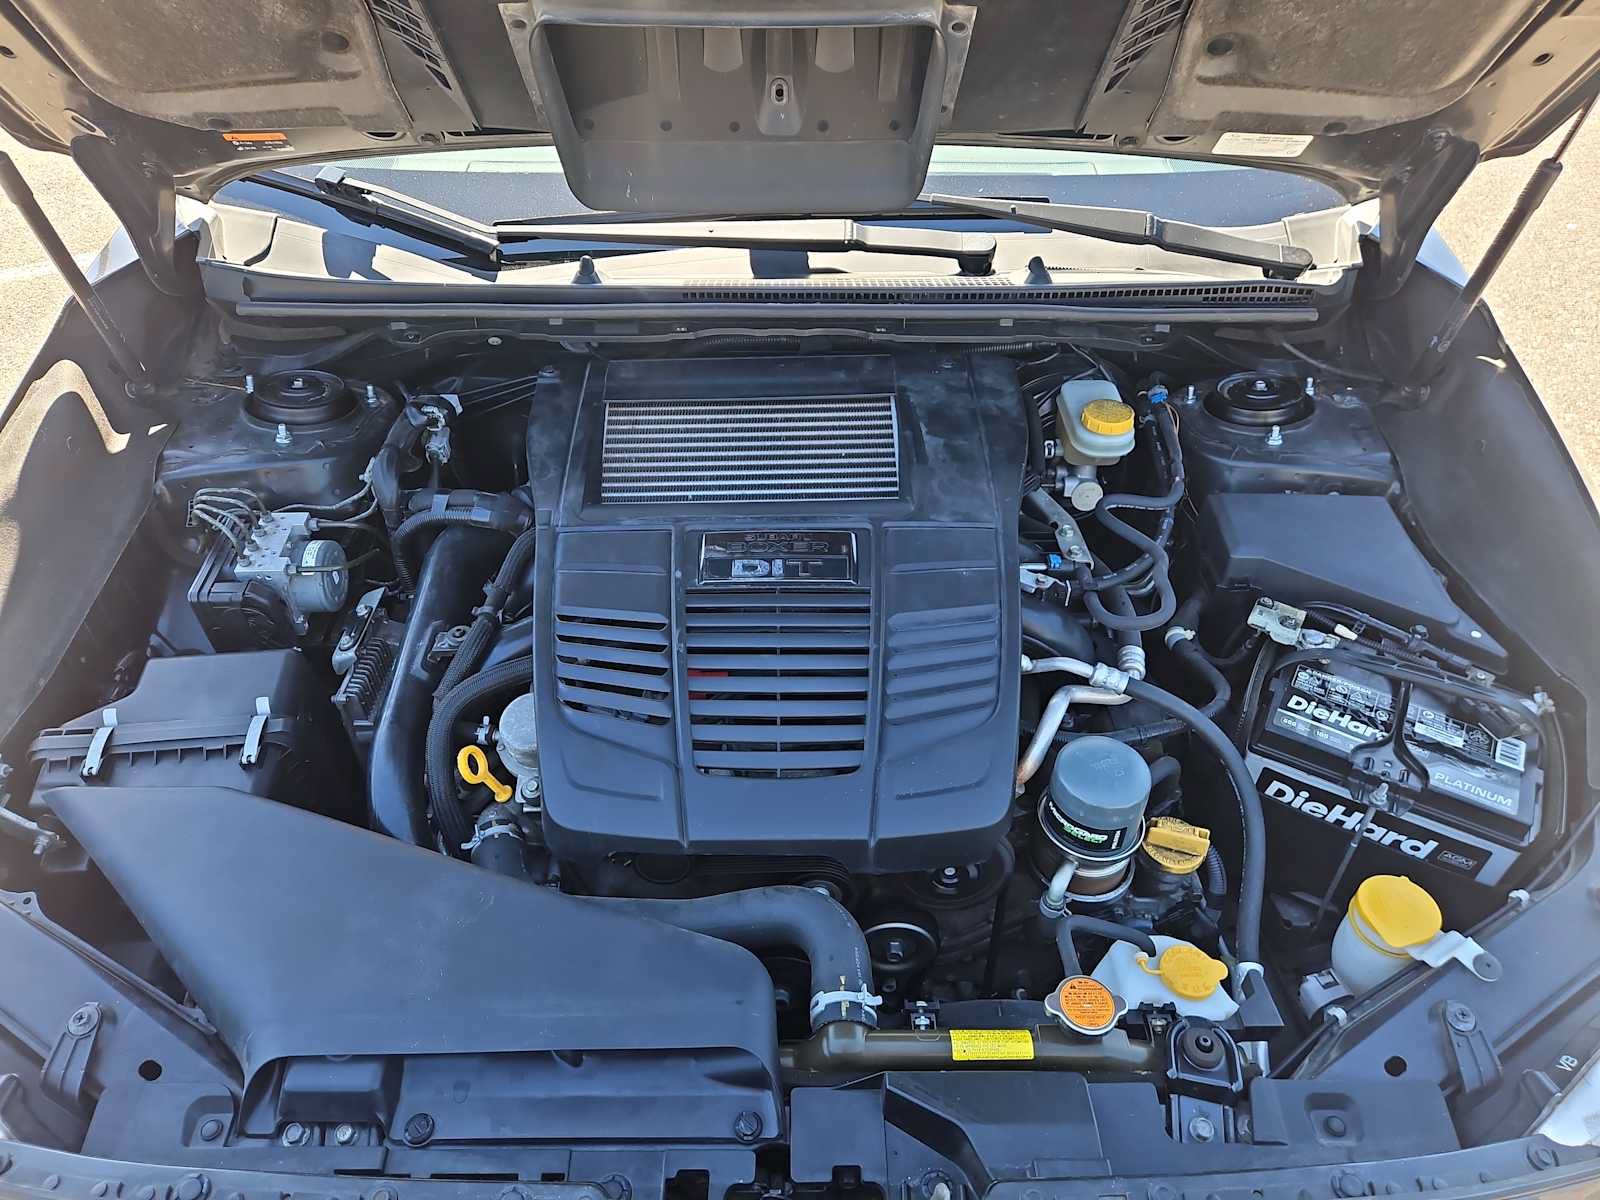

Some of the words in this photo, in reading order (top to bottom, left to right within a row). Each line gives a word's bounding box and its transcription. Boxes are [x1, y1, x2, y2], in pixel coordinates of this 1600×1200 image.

[727, 541, 830, 553] BOXER
[1434, 772, 1513, 807] PLATINUM
[1264, 780, 1439, 860] DieHard
